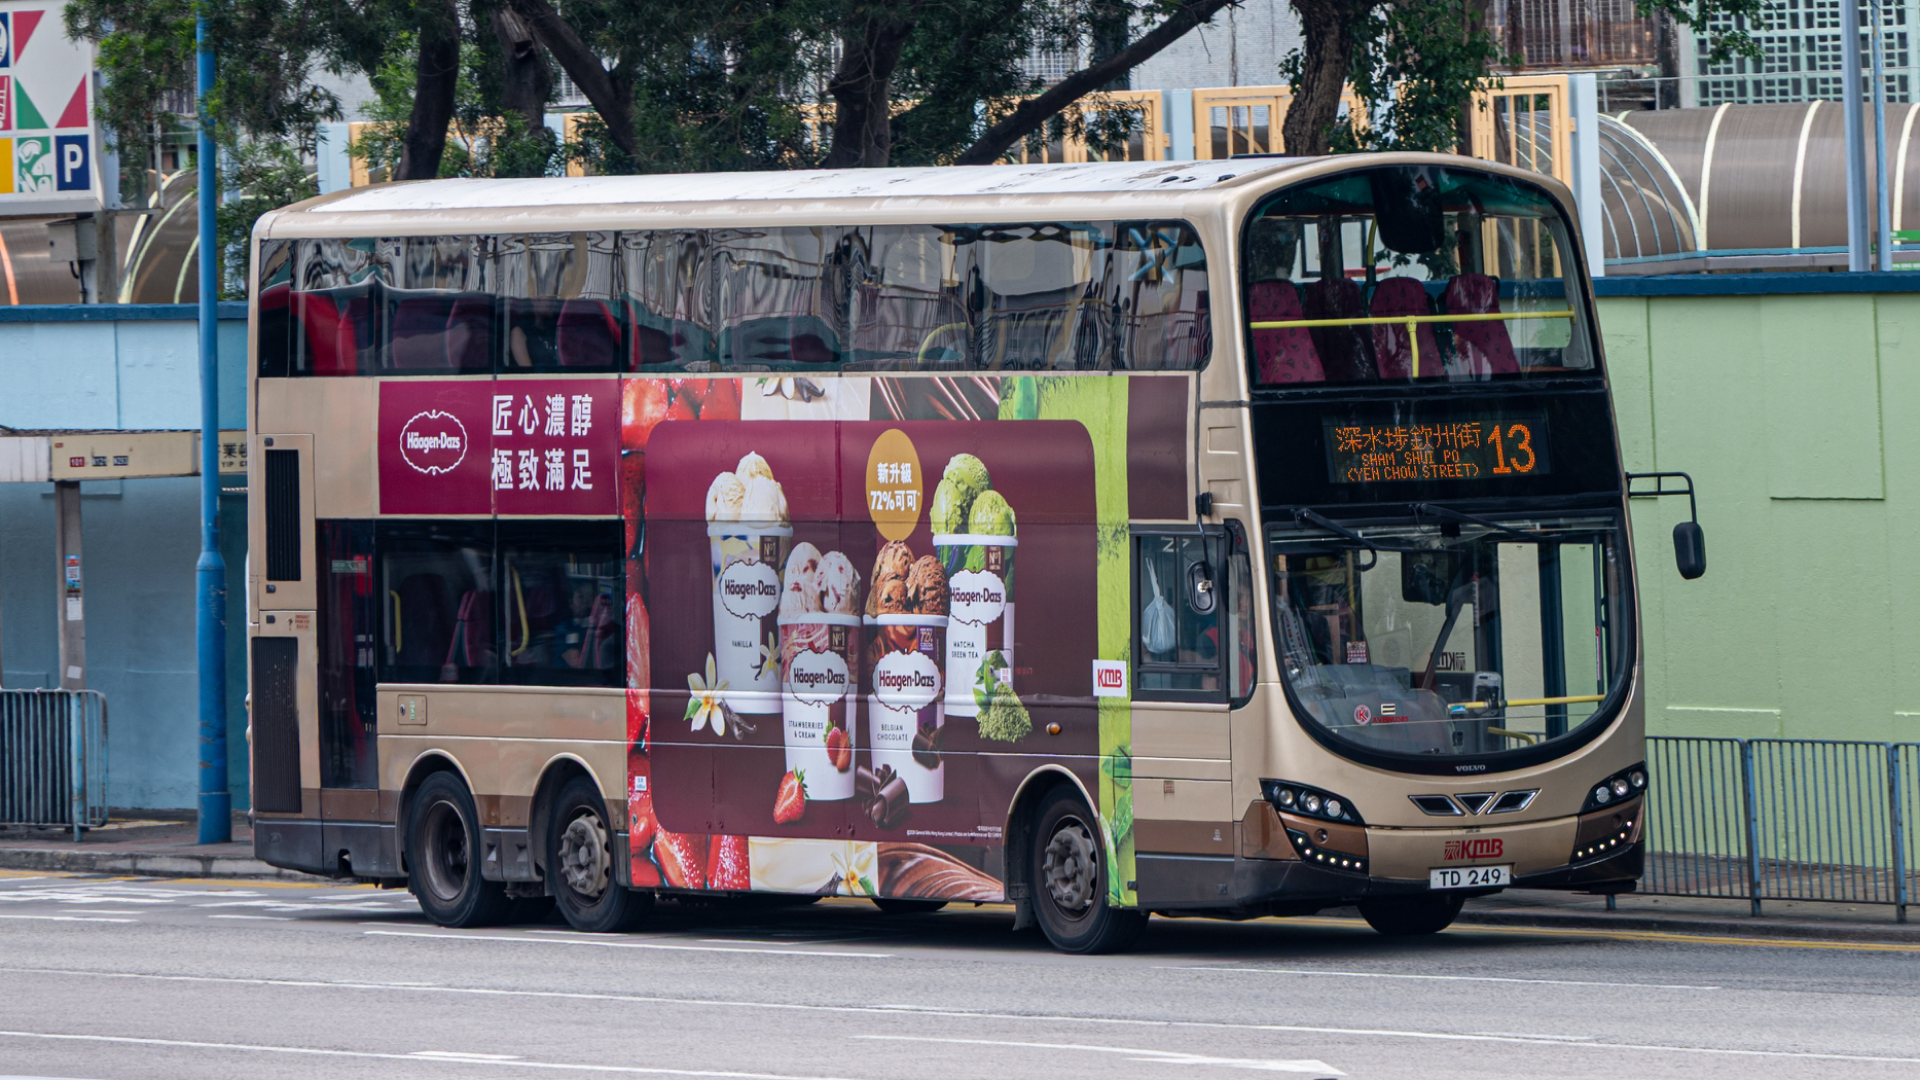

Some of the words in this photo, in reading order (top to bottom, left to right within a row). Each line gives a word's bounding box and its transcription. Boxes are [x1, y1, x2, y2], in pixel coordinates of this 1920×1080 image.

[63, 143, 83, 183] P
[492, 394, 593, 437] 匠心濃醇
[1335, 422, 1481, 453] 深水埗欽州街
[1361, 452, 1395, 467] SHAM
[1404, 450, 1434, 465] SHUI
[1443, 449, 1460, 463] PO
[1487, 424, 1536, 474] 13
[491, 448, 593, 491] 極致滿足
[877, 462, 912, 484] 新升級
[1347, 467, 1380, 482] (YEN
[1384, 465, 1417, 480] CHOW
[1422, 463, 1479, 479] STREET)
[724, 579, 777, 600] Häagen-Dazs
[731, 640, 753, 648] VANILLA
[968, 651, 979, 659] TEA
[793, 667, 846, 688] Häagen-Dazs
[878, 670, 935, 692] Häagen-Dazs
[1097, 668, 1123, 688] KMB
[788, 720, 824, 730] STRAWBERRIES
[798, 731, 816, 739] CREAM
[880, 723, 904, 732] BELGIAN
[876, 733, 908, 742] CHOCOLATE
[1455, 764, 1486, 772] VOLVO
[1460, 838, 1504, 860] KMB
[1439, 870, 1461, 887] TD
[1468, 868, 1501, 885] 249
